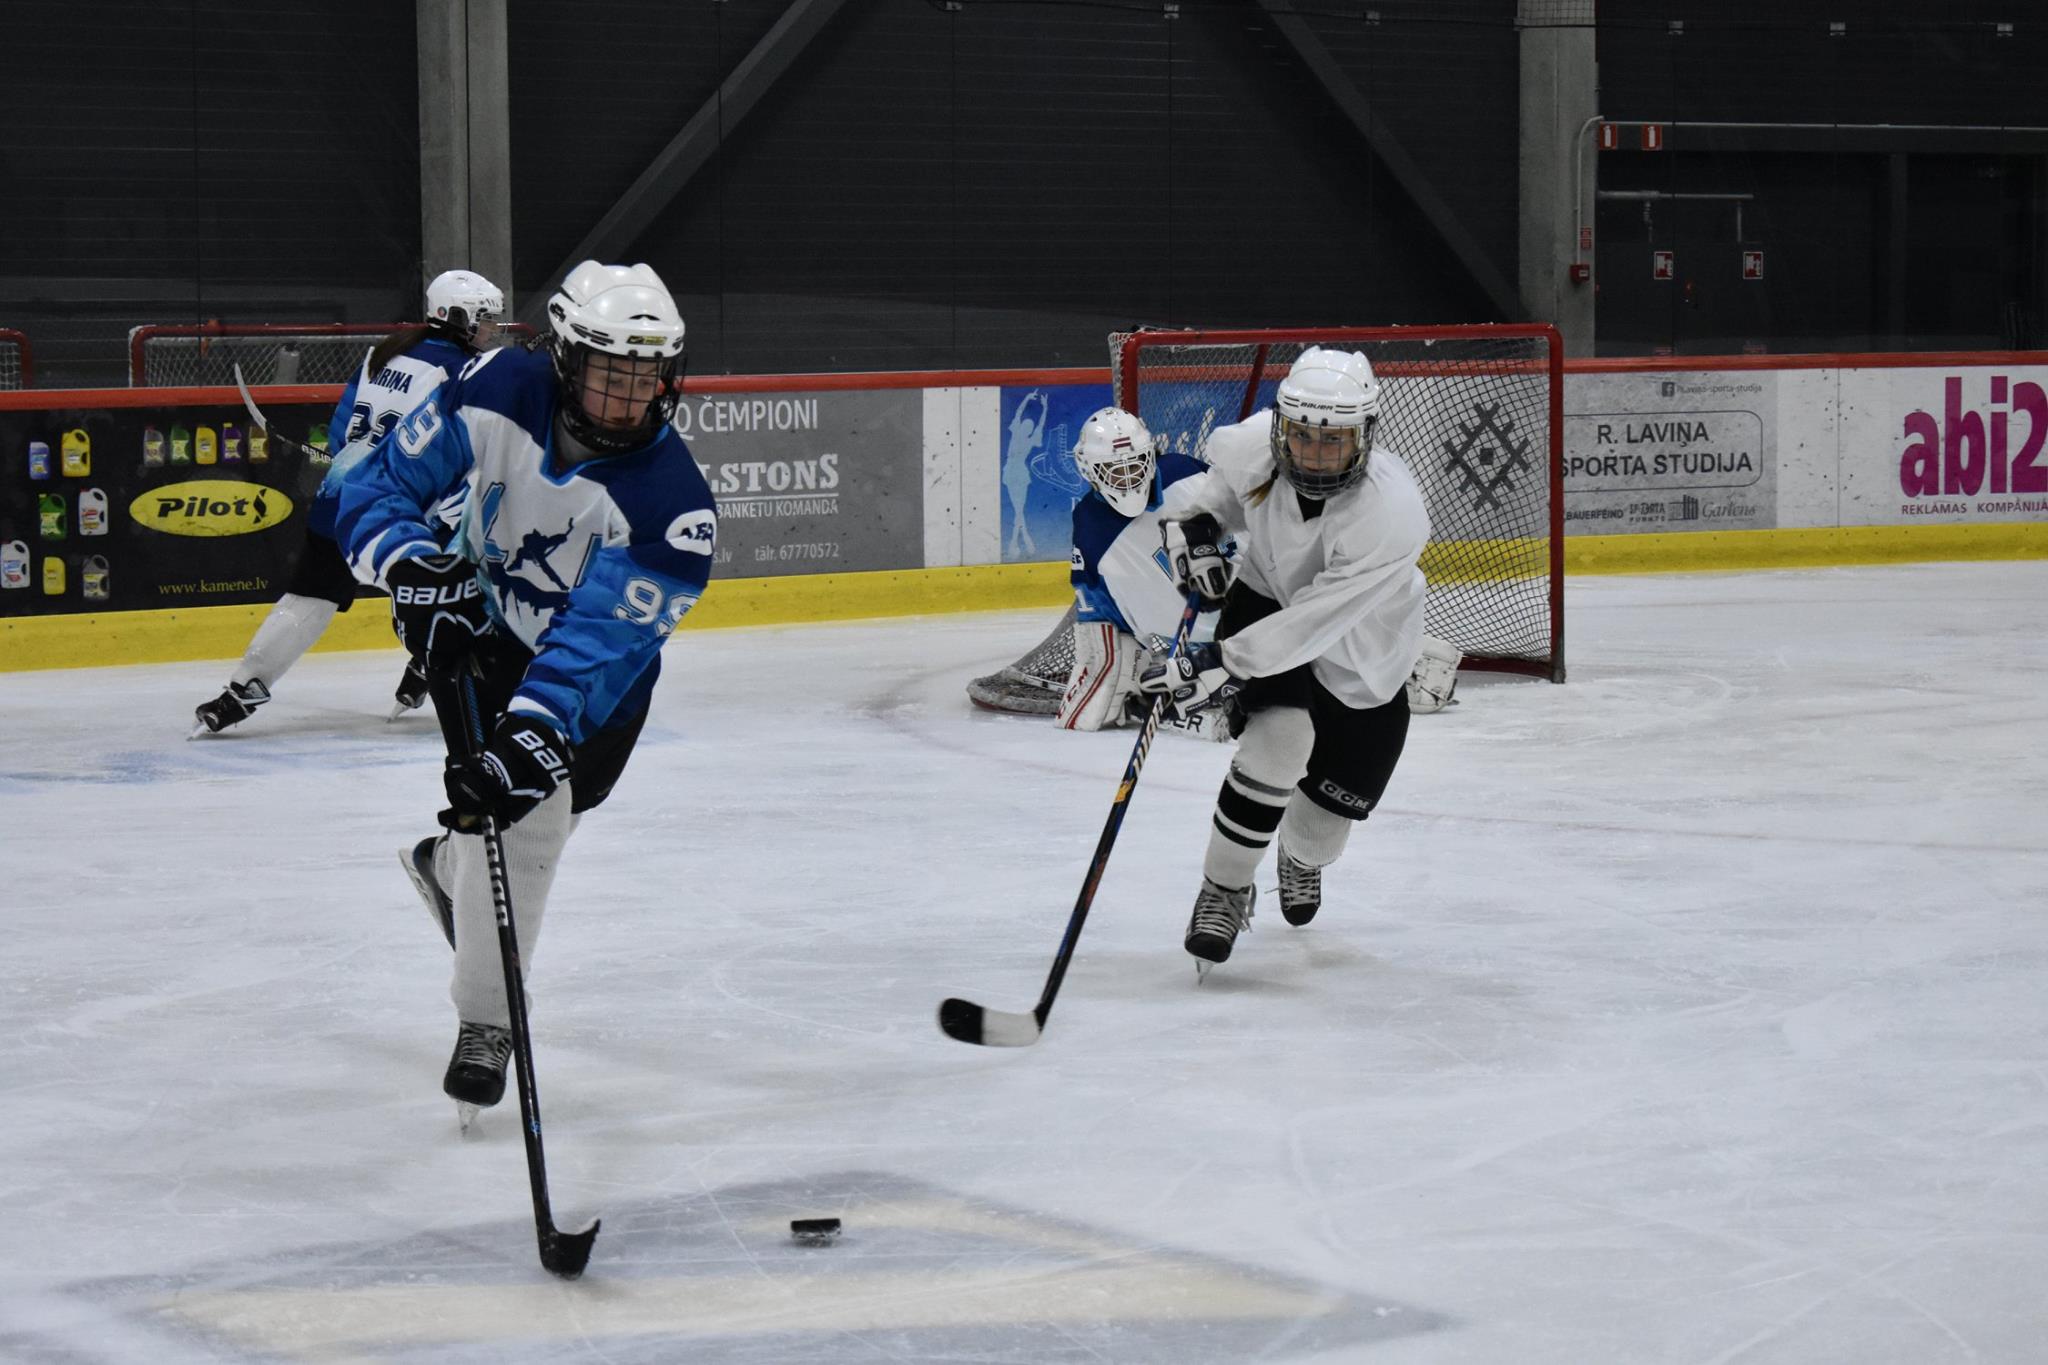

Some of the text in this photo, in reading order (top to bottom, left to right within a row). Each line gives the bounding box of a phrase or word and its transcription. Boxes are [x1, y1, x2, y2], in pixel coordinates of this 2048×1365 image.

[698, 395, 818, 432] ČEMPIONI
[1597, 422, 1709, 447] R. LAVIŅA
[1900, 376, 2048, 498] abi2
[696, 453, 839, 493] LSTONS
[1562, 452, 1752, 477] SPORTA STUDIJA
[776, 499, 839, 516] KOMANDA
[1902, 502, 1967, 515] REKLĀMAS
[780, 542, 839, 560] 67770572
[158, 576, 268, 595] www.kamene.lv
[396, 577, 480, 605] BAUE
[1318, 778, 1371, 811] CCM
